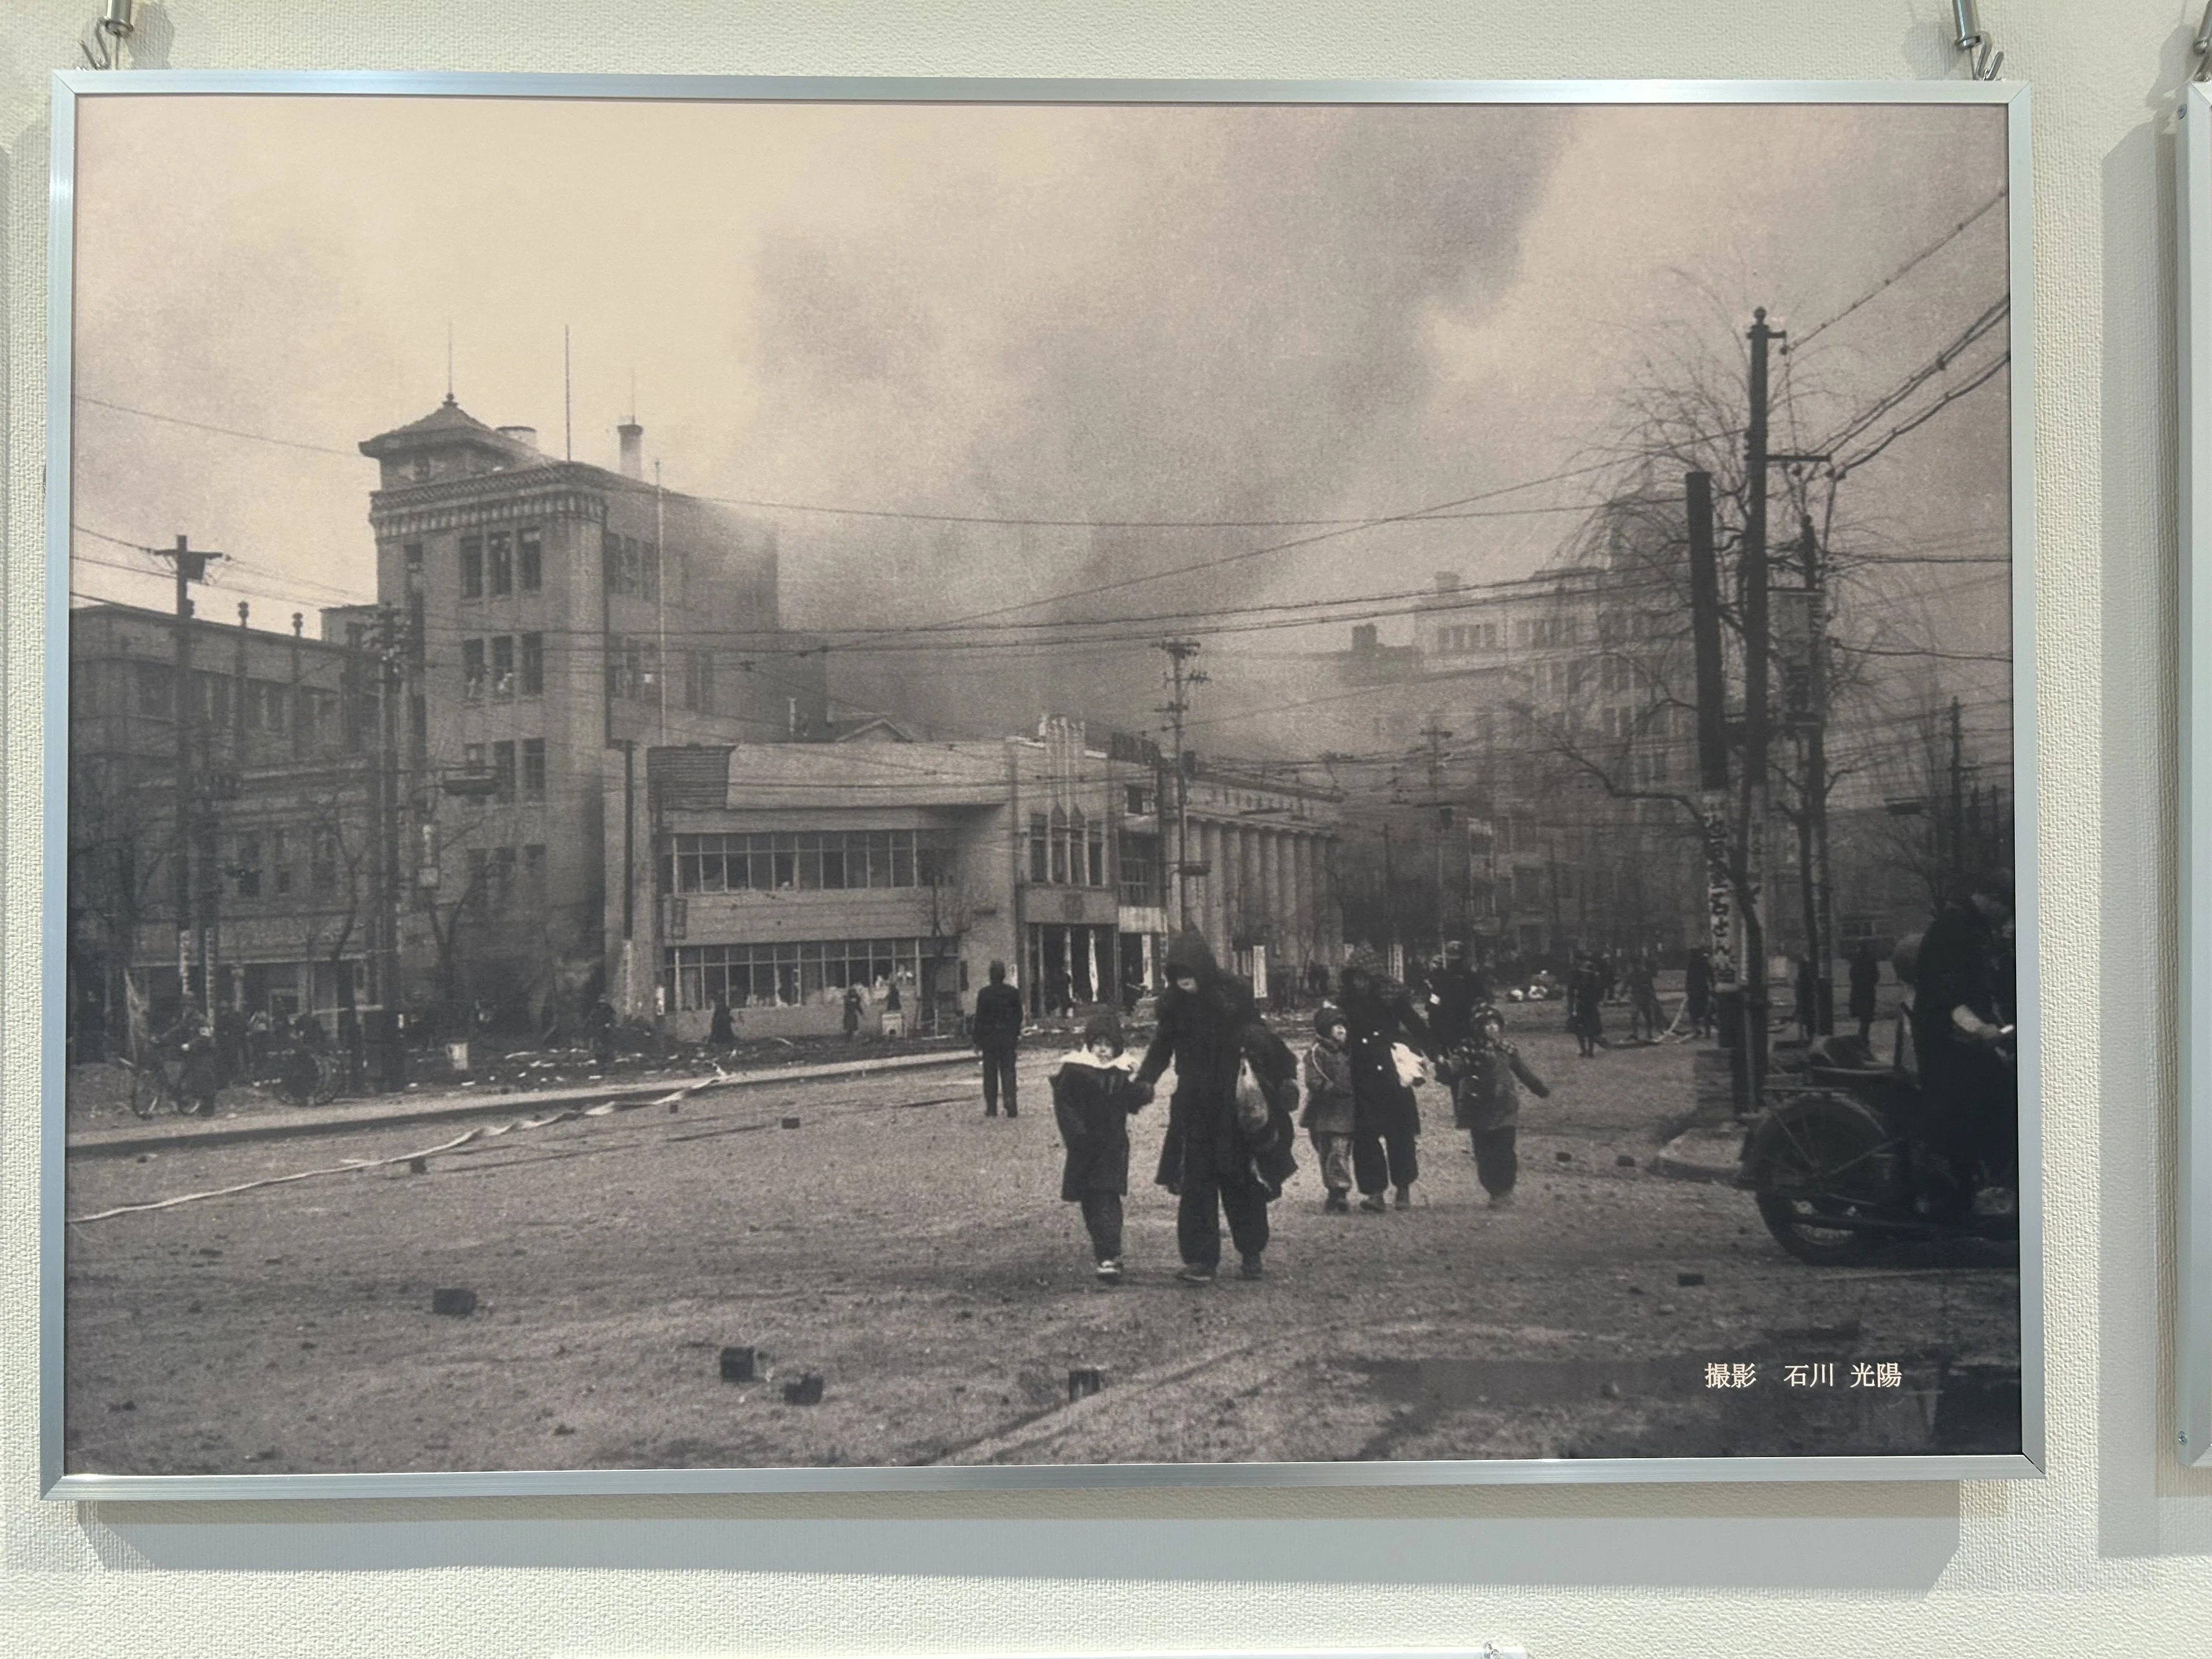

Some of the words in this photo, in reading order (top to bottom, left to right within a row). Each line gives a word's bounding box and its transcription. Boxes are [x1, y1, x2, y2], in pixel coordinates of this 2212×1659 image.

[1704, 1362, 1757, 1389] 撮影
[1784, 1363, 1833, 1387] 石川
[1850, 1362, 1902, 1388] 光陽
